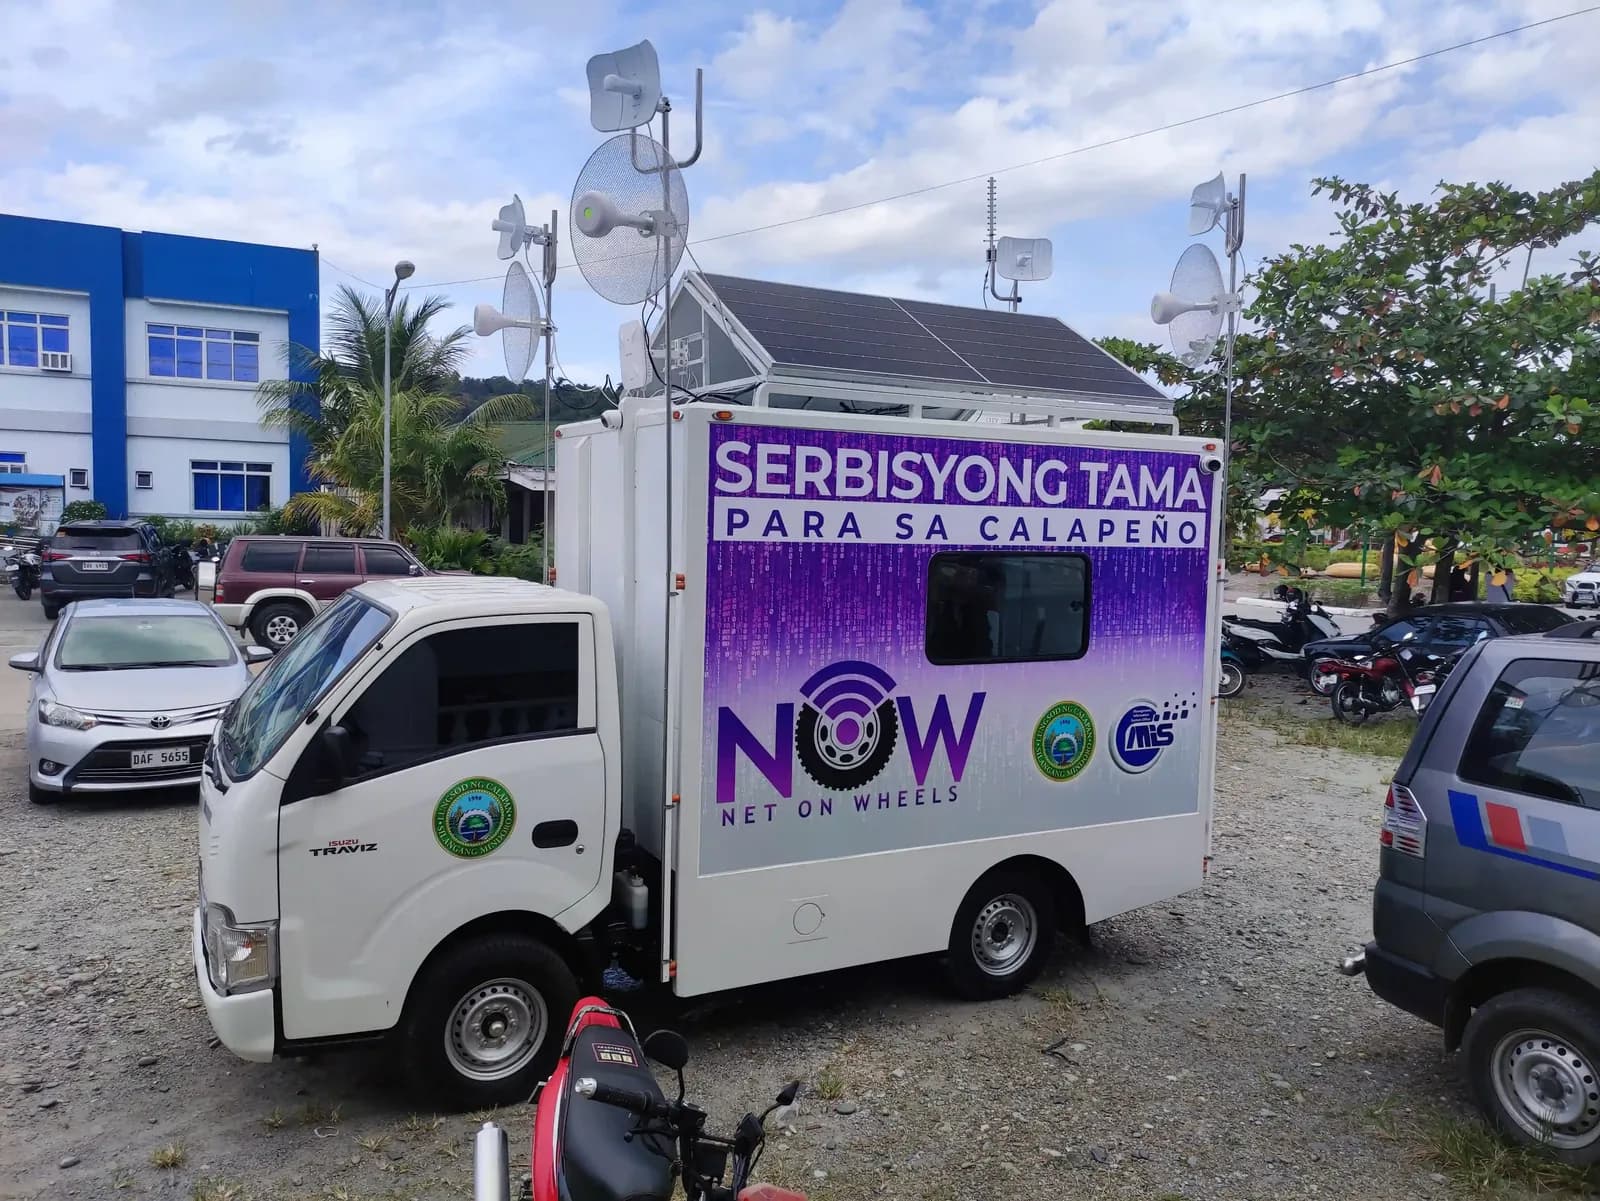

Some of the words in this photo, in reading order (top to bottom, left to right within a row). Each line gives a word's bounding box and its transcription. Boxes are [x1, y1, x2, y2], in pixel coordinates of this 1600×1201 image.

[714, 440, 1068, 505] SERBISYONG
[1079, 461, 1207, 509] TAMA
[726, 508, 862, 539] PARA
[895, 513, 948, 540] SA
[979, 514, 1198, 545] CALAPEÑO
[716, 660, 987, 803] NOW
[133, 753, 153, 765] DAF
[161, 751, 188, 763] 5655
[437, 783, 469, 821] LUNGSOD
[470, 781, 485, 790] NG
[486, 782, 512, 814] CALAPAN
[721, 804, 777, 827] NET
[798, 799, 833, 818] ON
[854, 785, 959, 812] WHEELS
[309, 843, 378, 857] TRAVIZ
[328, 839, 359, 847] ISUZU
[437, 825, 478, 855] SILANGANG
[480, 819, 513, 854] MINDORO
